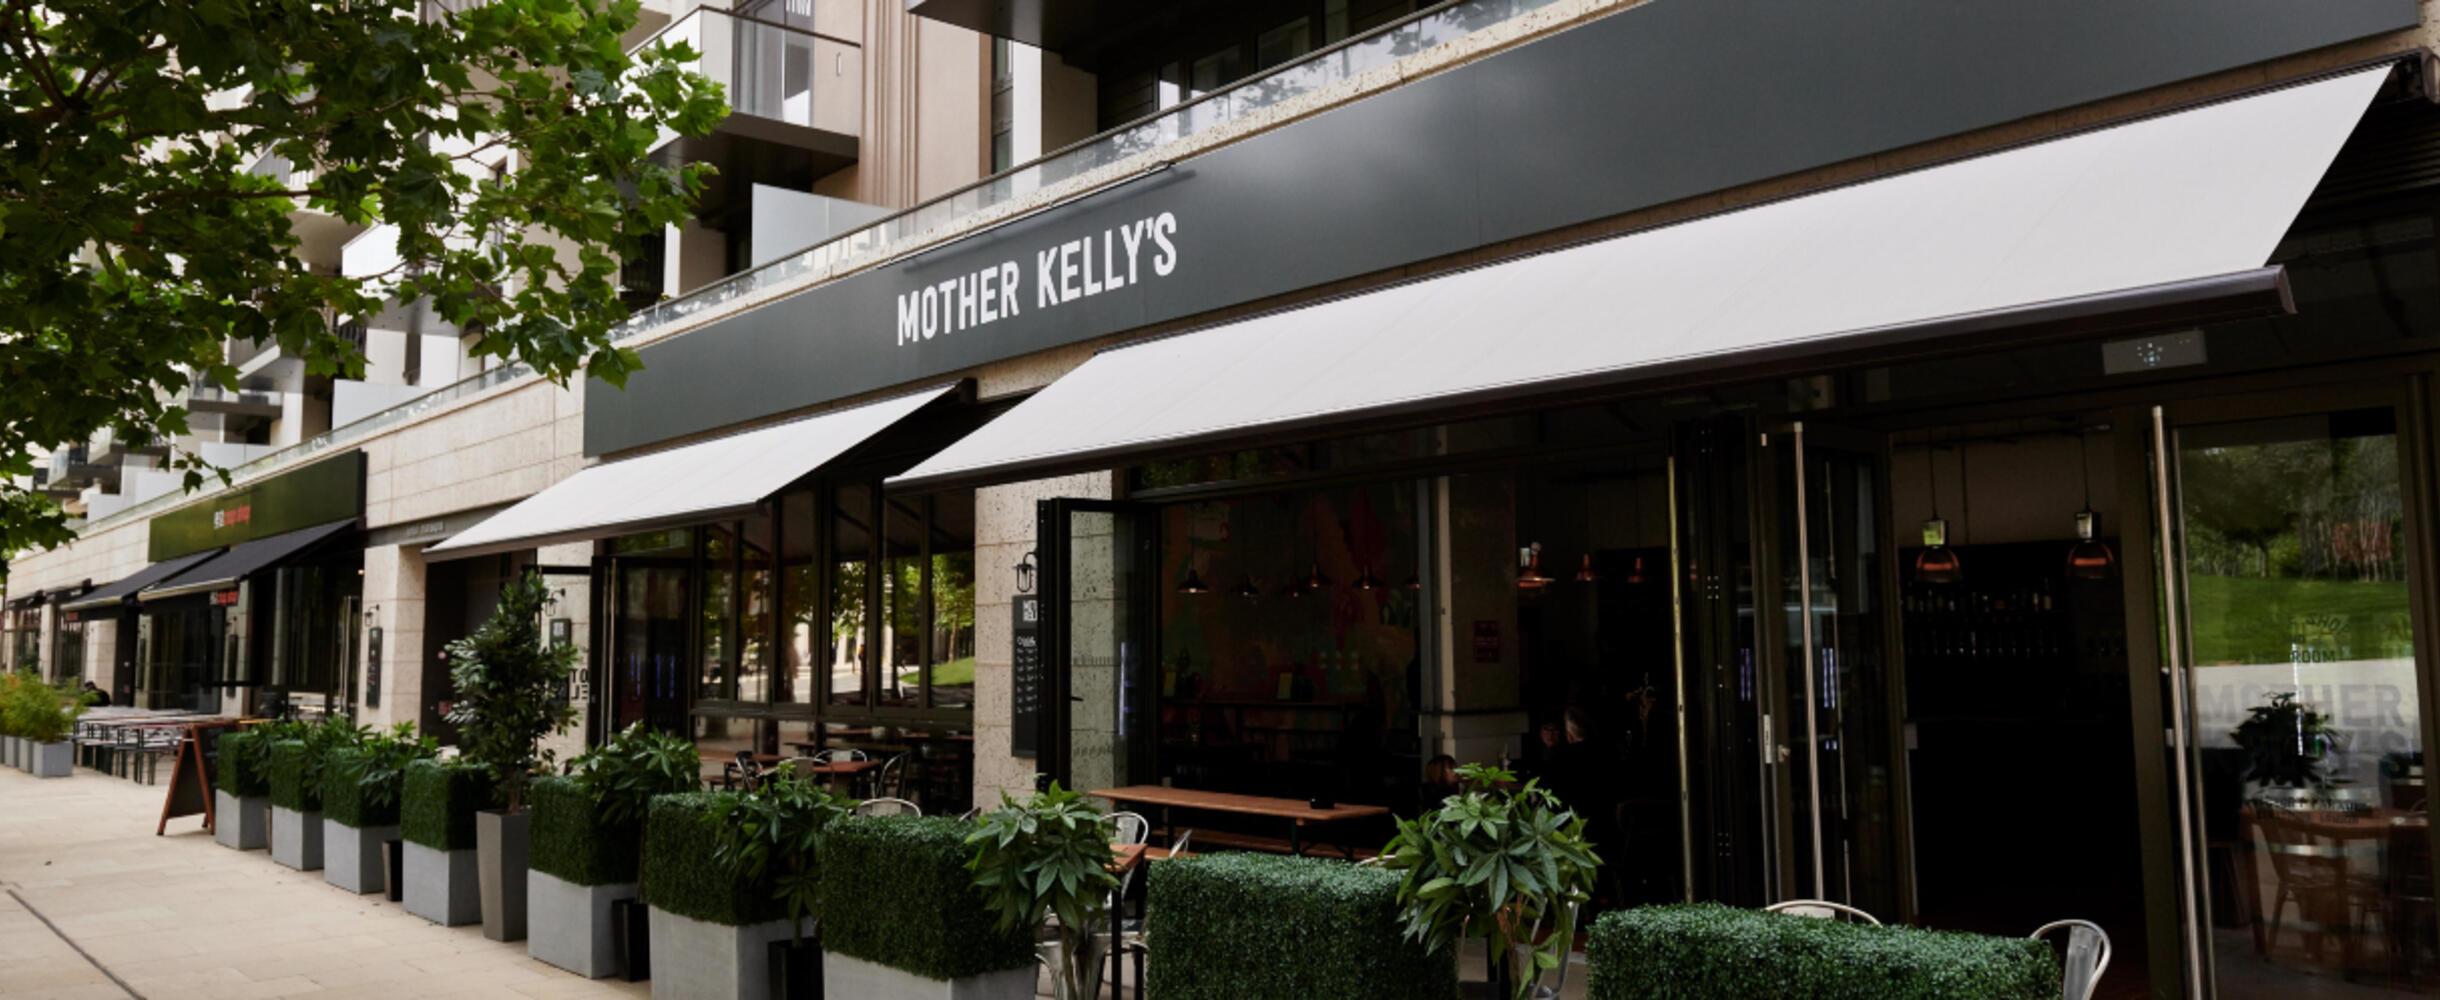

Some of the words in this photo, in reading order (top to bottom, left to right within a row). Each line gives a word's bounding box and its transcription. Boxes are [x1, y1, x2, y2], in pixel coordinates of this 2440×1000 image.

[897, 261, 1020, 346] MOTHER
[1037, 211, 1177, 308] KELLY'S
[2289, 650, 2336, 663] ROOM
